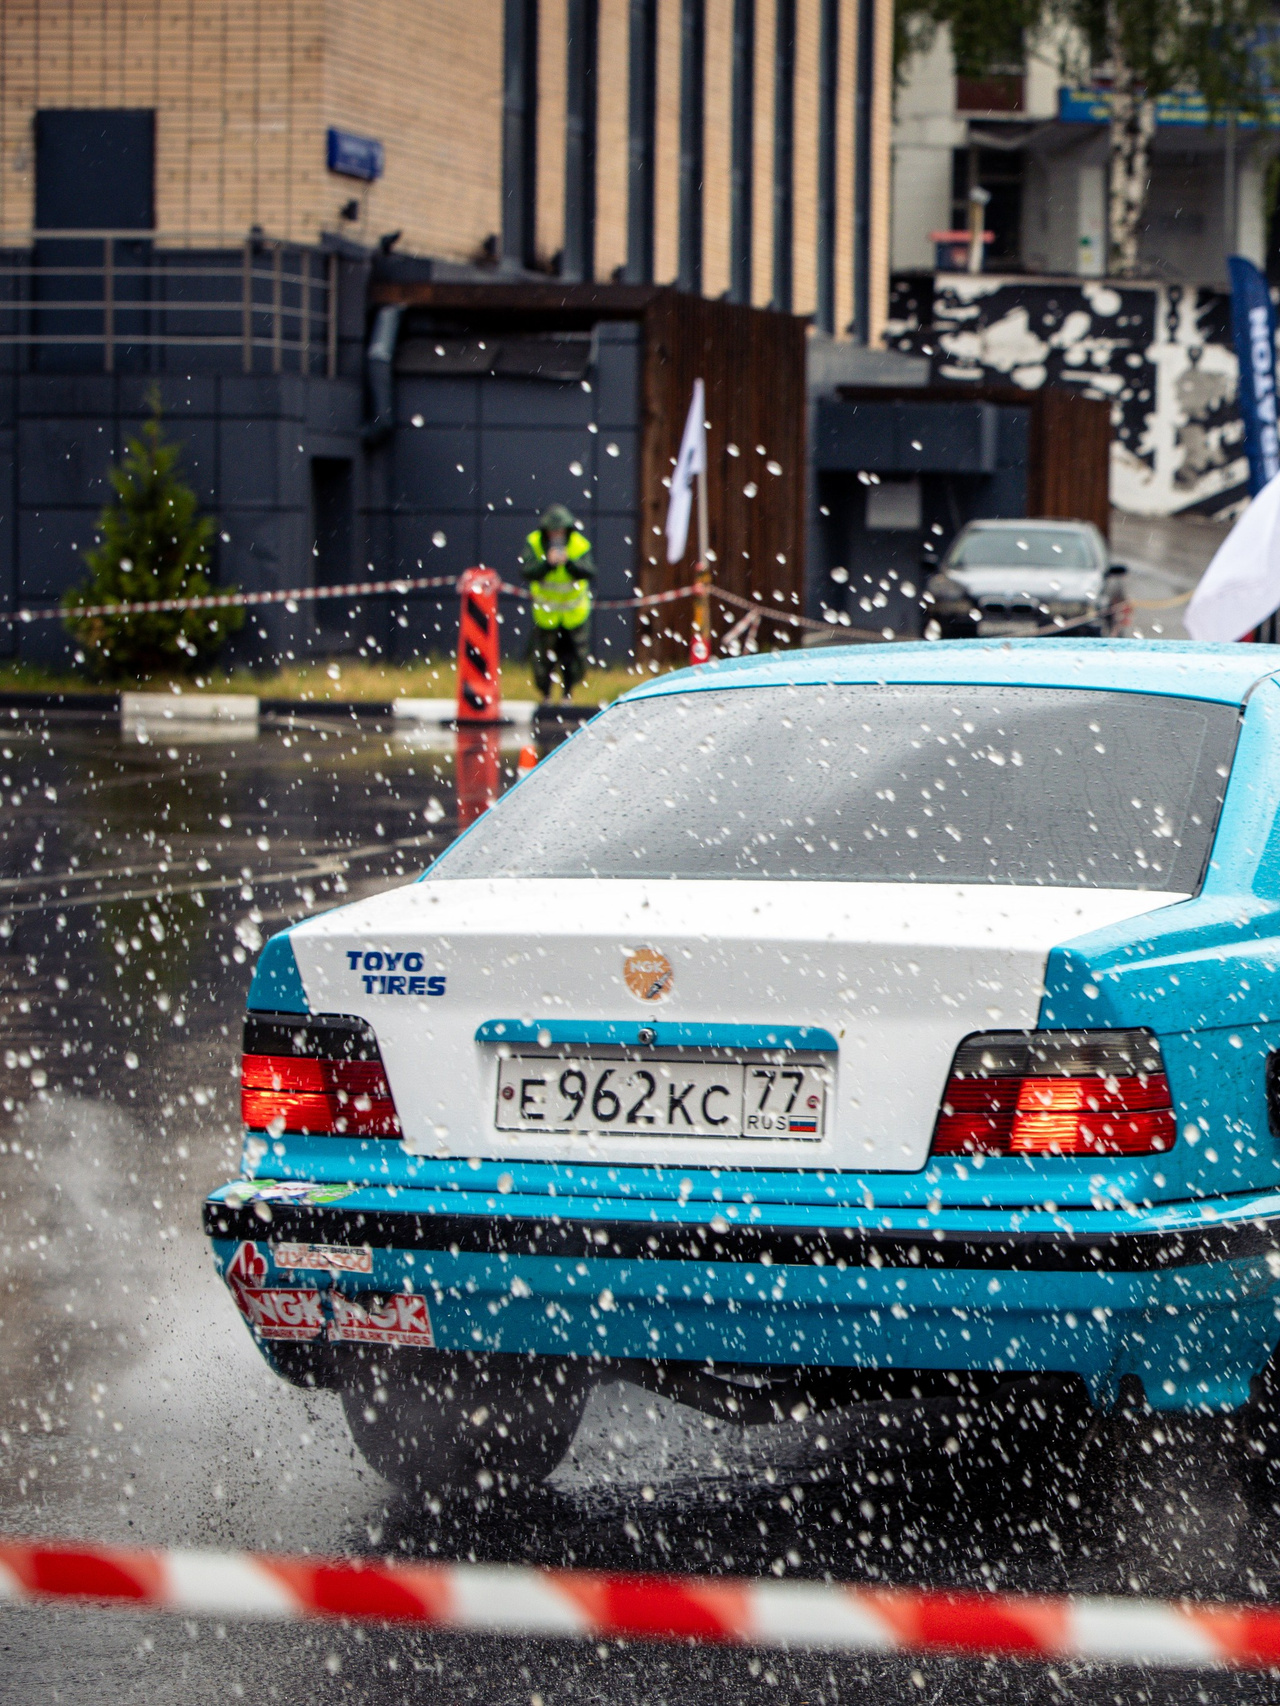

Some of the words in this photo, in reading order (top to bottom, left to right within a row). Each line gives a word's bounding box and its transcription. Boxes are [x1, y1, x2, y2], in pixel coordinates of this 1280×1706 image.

[1249, 306, 1280, 482] ERATON
[346, 951, 425, 972] TOYO
[630, 960, 666, 974] NGK
[362, 975, 447, 997] TIRES
[519, 1068, 731, 1126] E962KC
[752, 1070, 805, 1113] 77
[747, 1115, 787, 1131] RUS
[246, 1292, 324, 1327] NGK
[342, 1329, 384, 1342] SPARK
[387, 1333, 430, 1346] PLUGS
